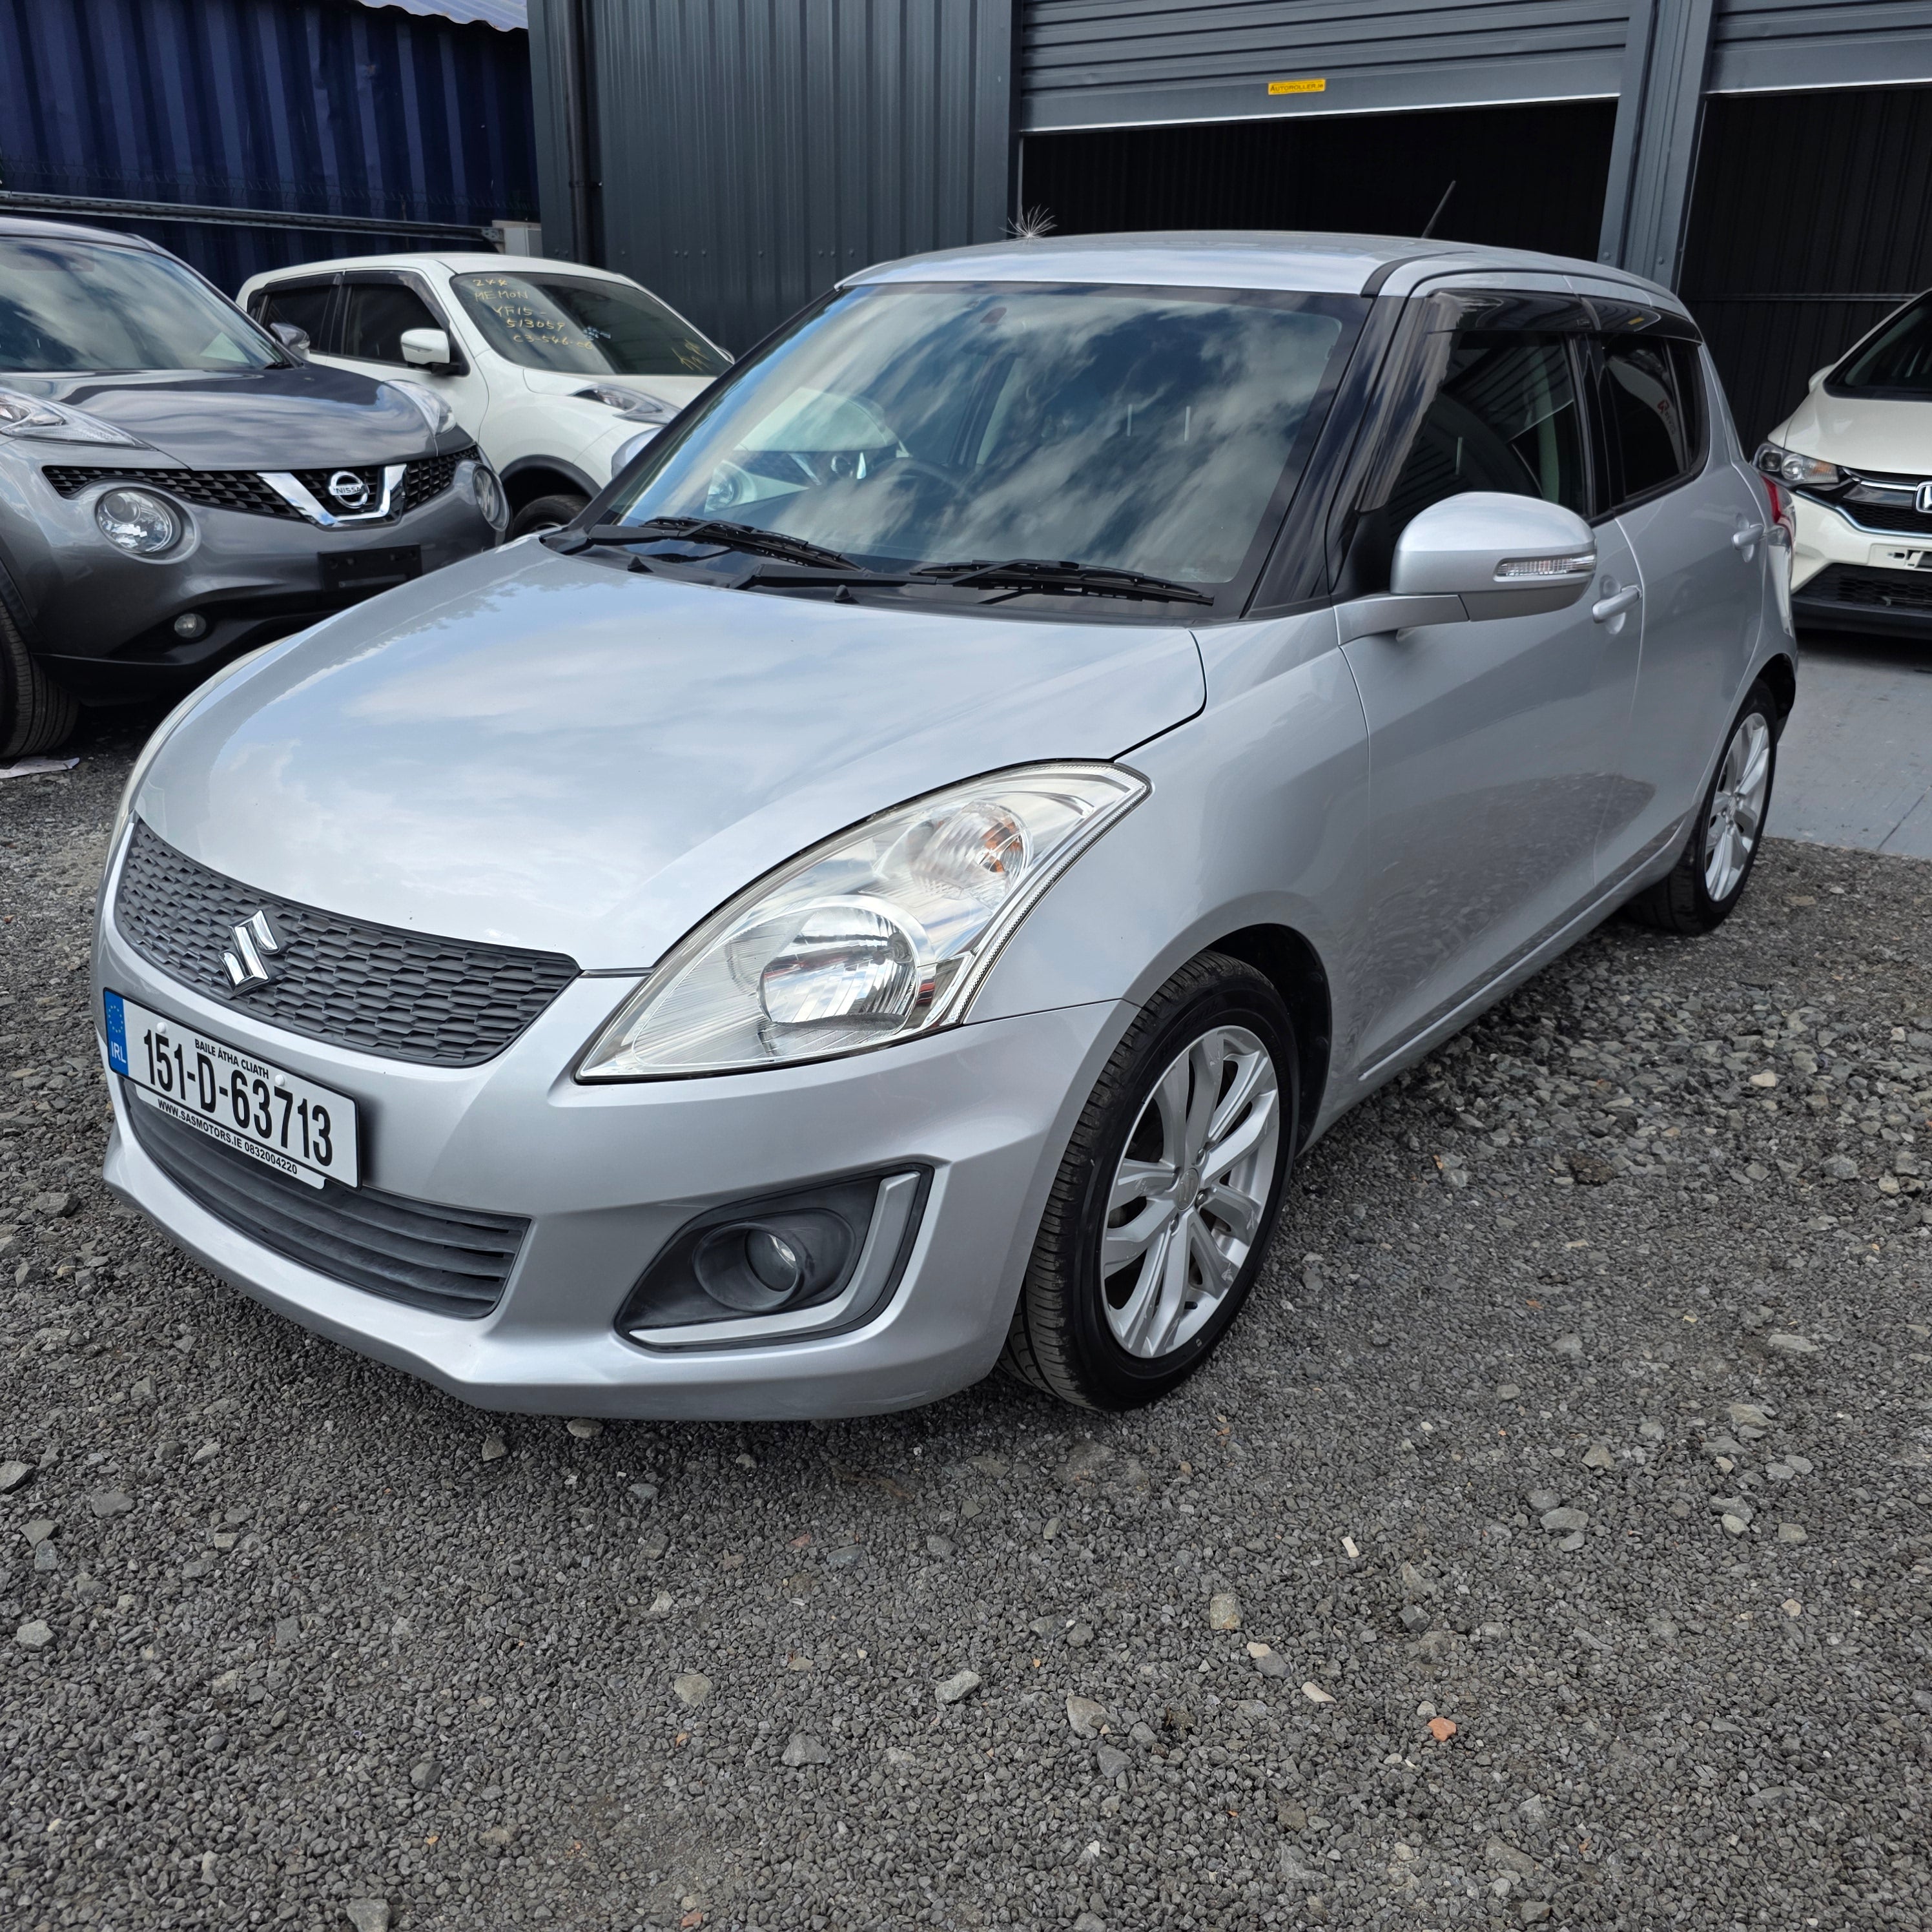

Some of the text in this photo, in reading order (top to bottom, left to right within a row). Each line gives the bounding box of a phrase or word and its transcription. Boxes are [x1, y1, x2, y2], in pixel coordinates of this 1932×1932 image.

[111, 1041, 127, 1064] IRL
[195, 1038, 269, 1080] BAILE ÁTHA CLIATH
[144, 1029, 333, 1167] 151-D-63713
[158, 1098, 298, 1175] WWW.SASMOTORS.IE 0832004220
